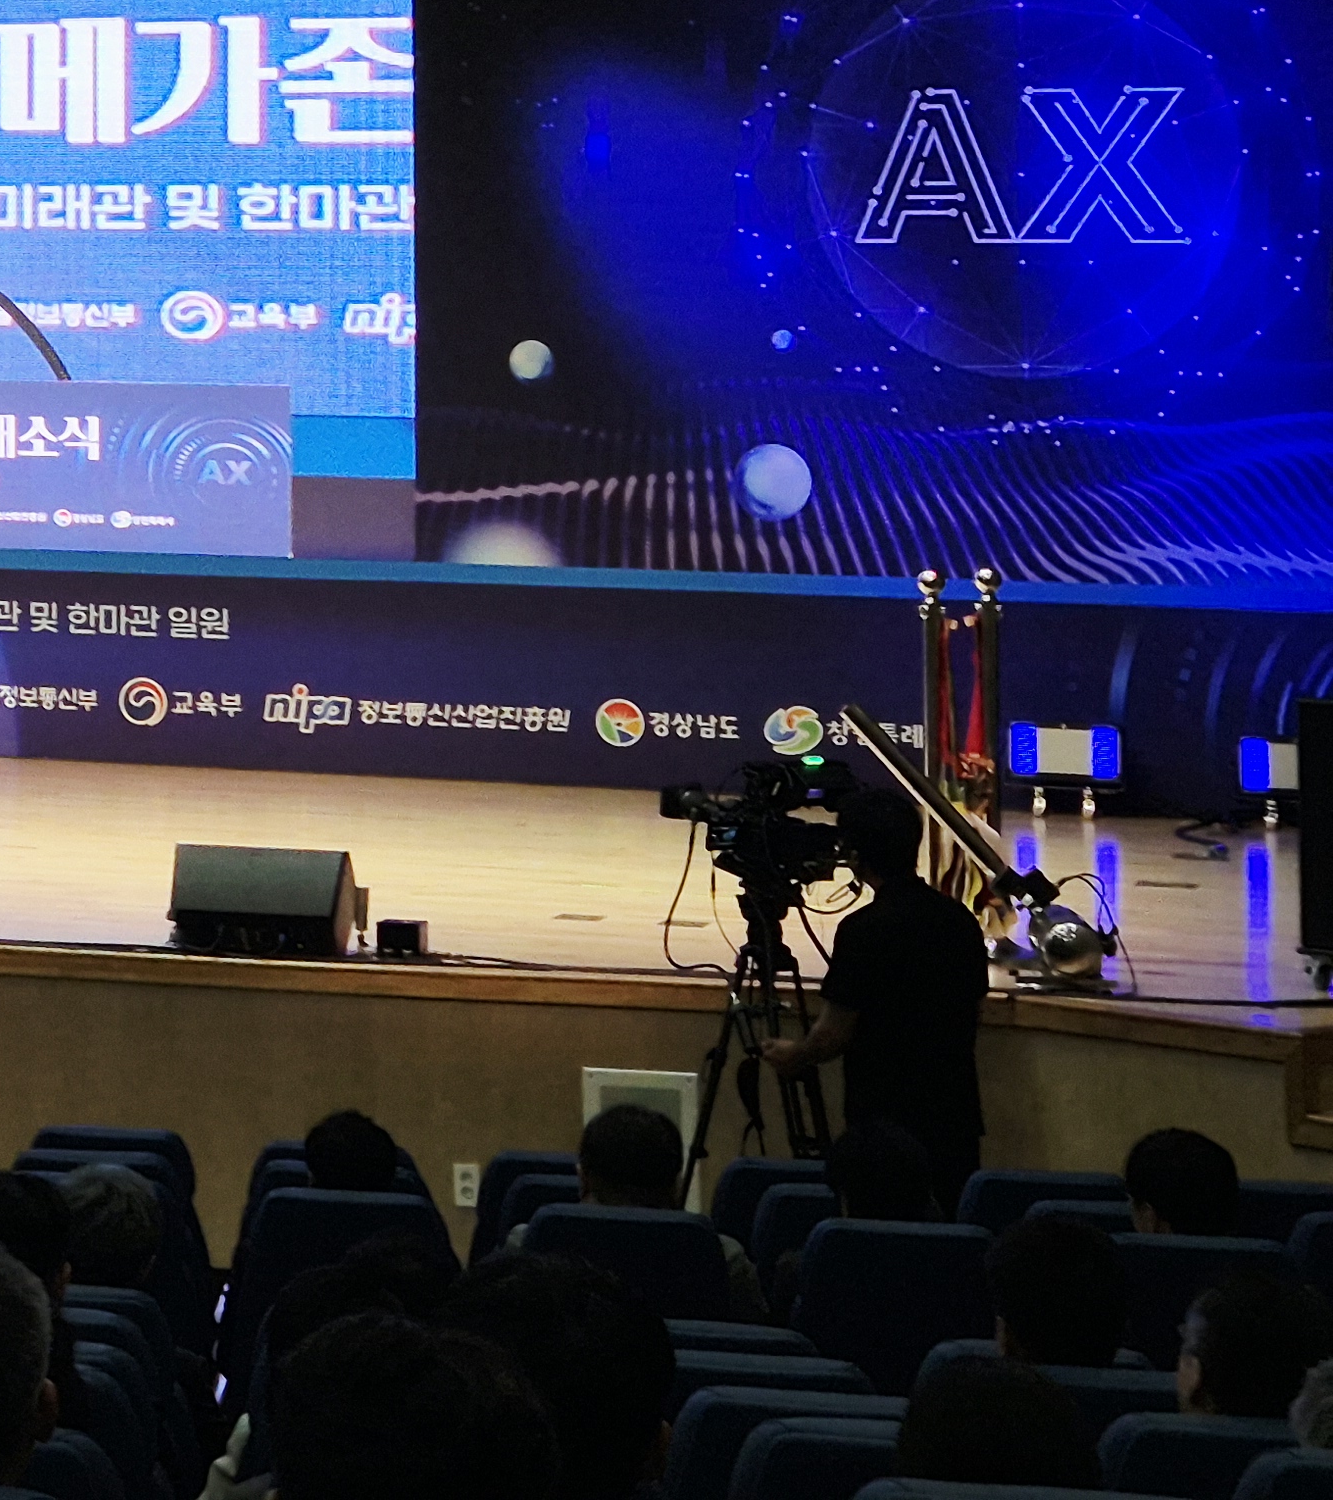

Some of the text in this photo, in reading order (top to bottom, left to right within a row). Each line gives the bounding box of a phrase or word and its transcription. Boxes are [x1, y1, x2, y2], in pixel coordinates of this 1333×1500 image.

[855, 85, 1192, 246] AX
[166, 182, 220, 233] 및
[236, 182, 415, 232] 한마관
[228, 301, 319, 331] 교육부
[197, 459, 252, 486] AX
[29, 600, 60, 634] 및
[67, 602, 160, 639] 한마관
[168, 606, 231, 640] 일원
[170, 690, 243, 717] 교육부
[264, 683, 352, 734] nipa
[357, 698, 572, 734] 정보통신산업진흥원
[648, 709, 741, 740] 경상남도
